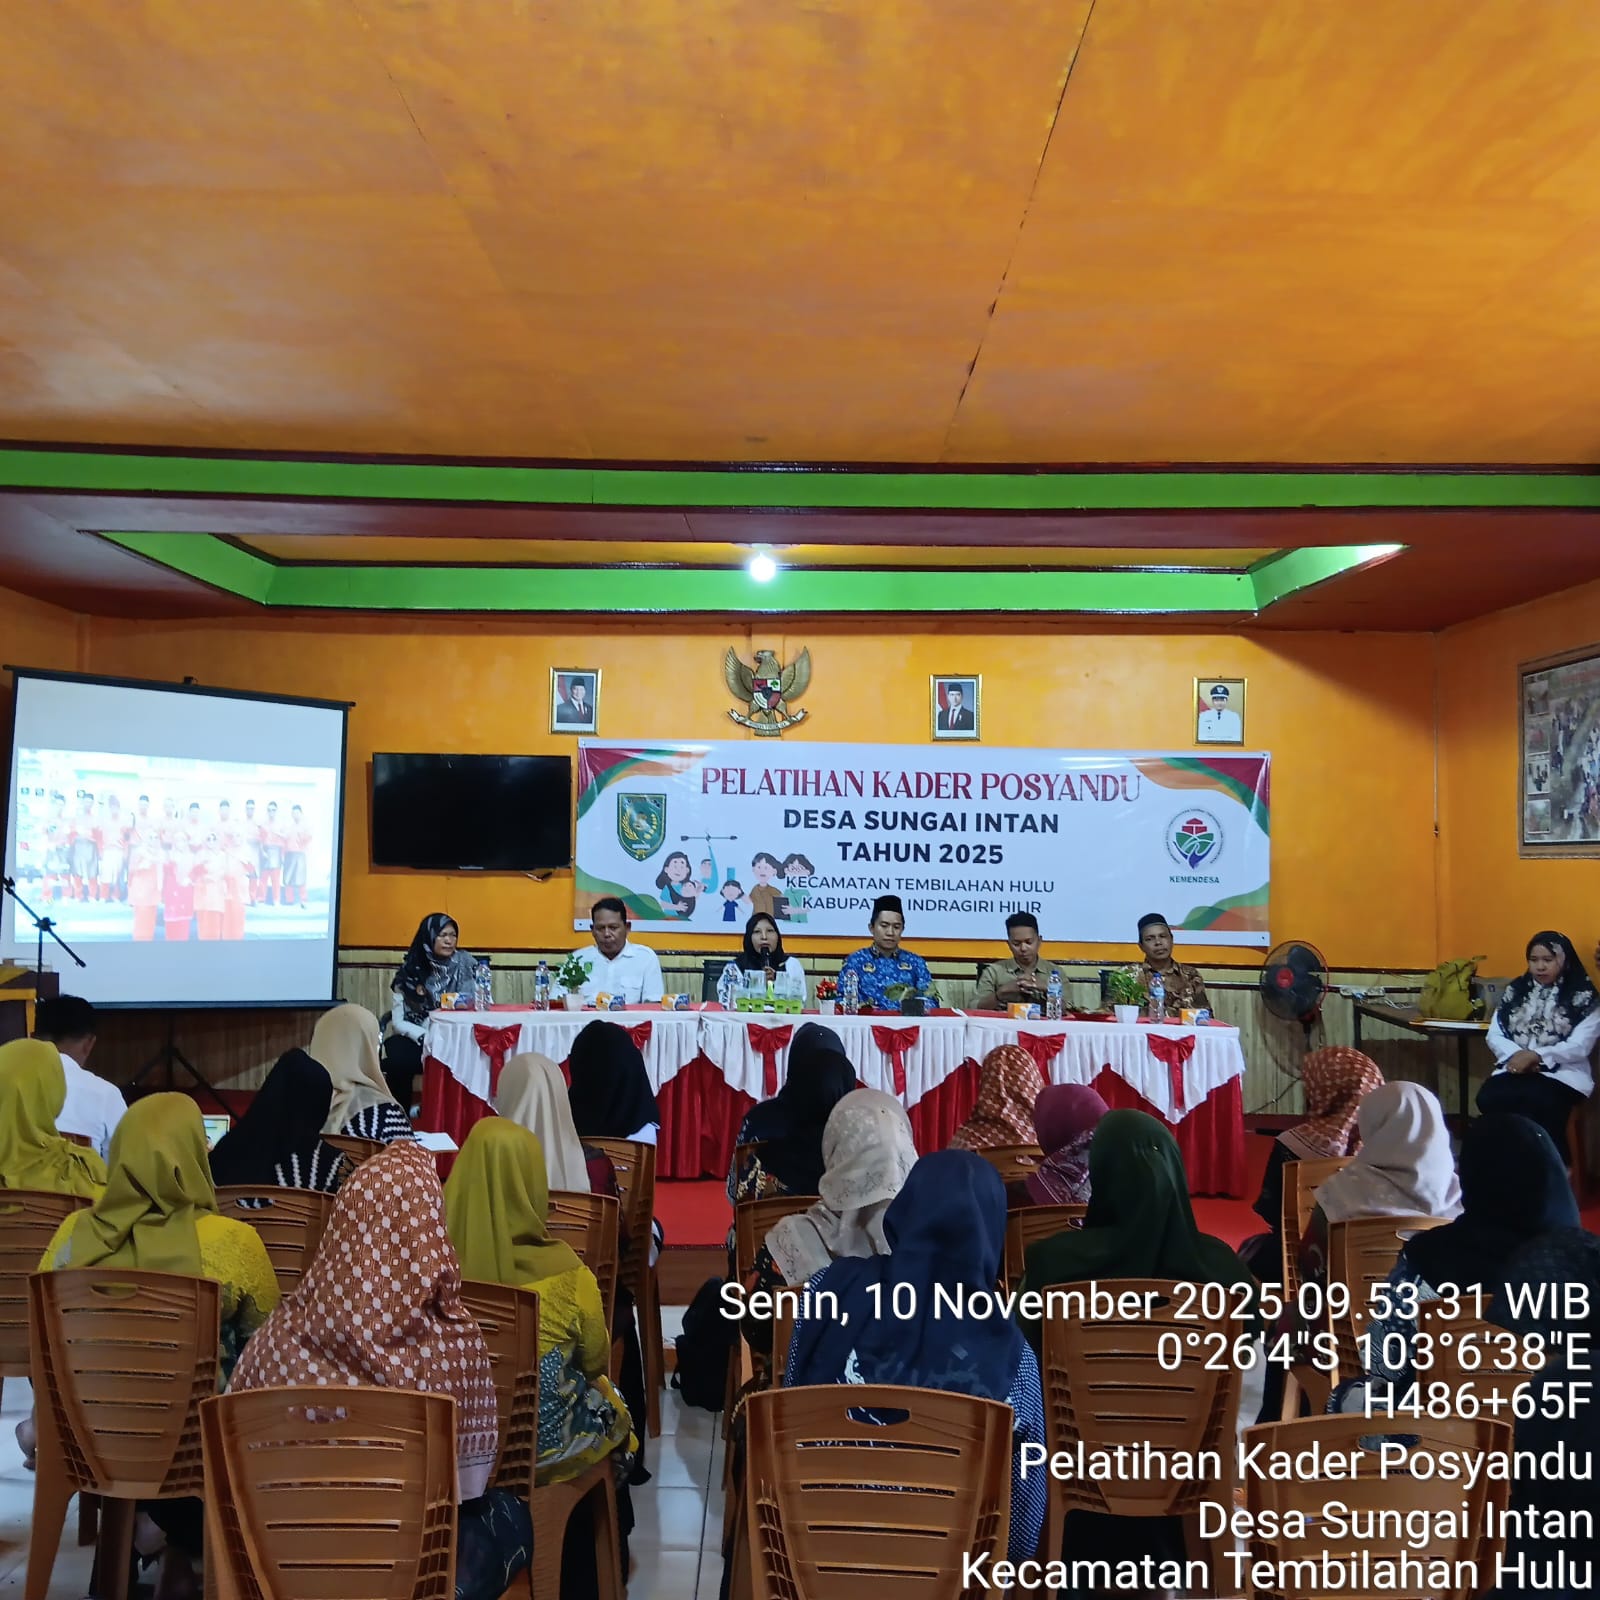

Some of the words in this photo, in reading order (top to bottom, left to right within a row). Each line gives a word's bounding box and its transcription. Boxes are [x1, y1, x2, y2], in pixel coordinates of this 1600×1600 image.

[701, 767, 864, 799] PELATIHAN
[872, 770, 973, 800] KADER
[981, 772, 1142, 802] POSYANDU
[783, 808, 857, 831] DESA
[863, 809, 967, 832] SUNGAI
[975, 812, 1059, 834] INTAN
[836, 841, 931, 863] TAHUN
[939, 843, 1004, 865] 2025
[786, 876, 890, 890] KECAMATAN
[895, 878, 1004, 892] TEMBILAHAN
[1009, 880, 1055, 893] HULU
[1169, 875, 1220, 884] KEMENDESA
[802, 896, 877, 911] KABUPA
[907, 898, 994, 913] INDRAGIRI
[999, 900, 1042, 914] HILIR
